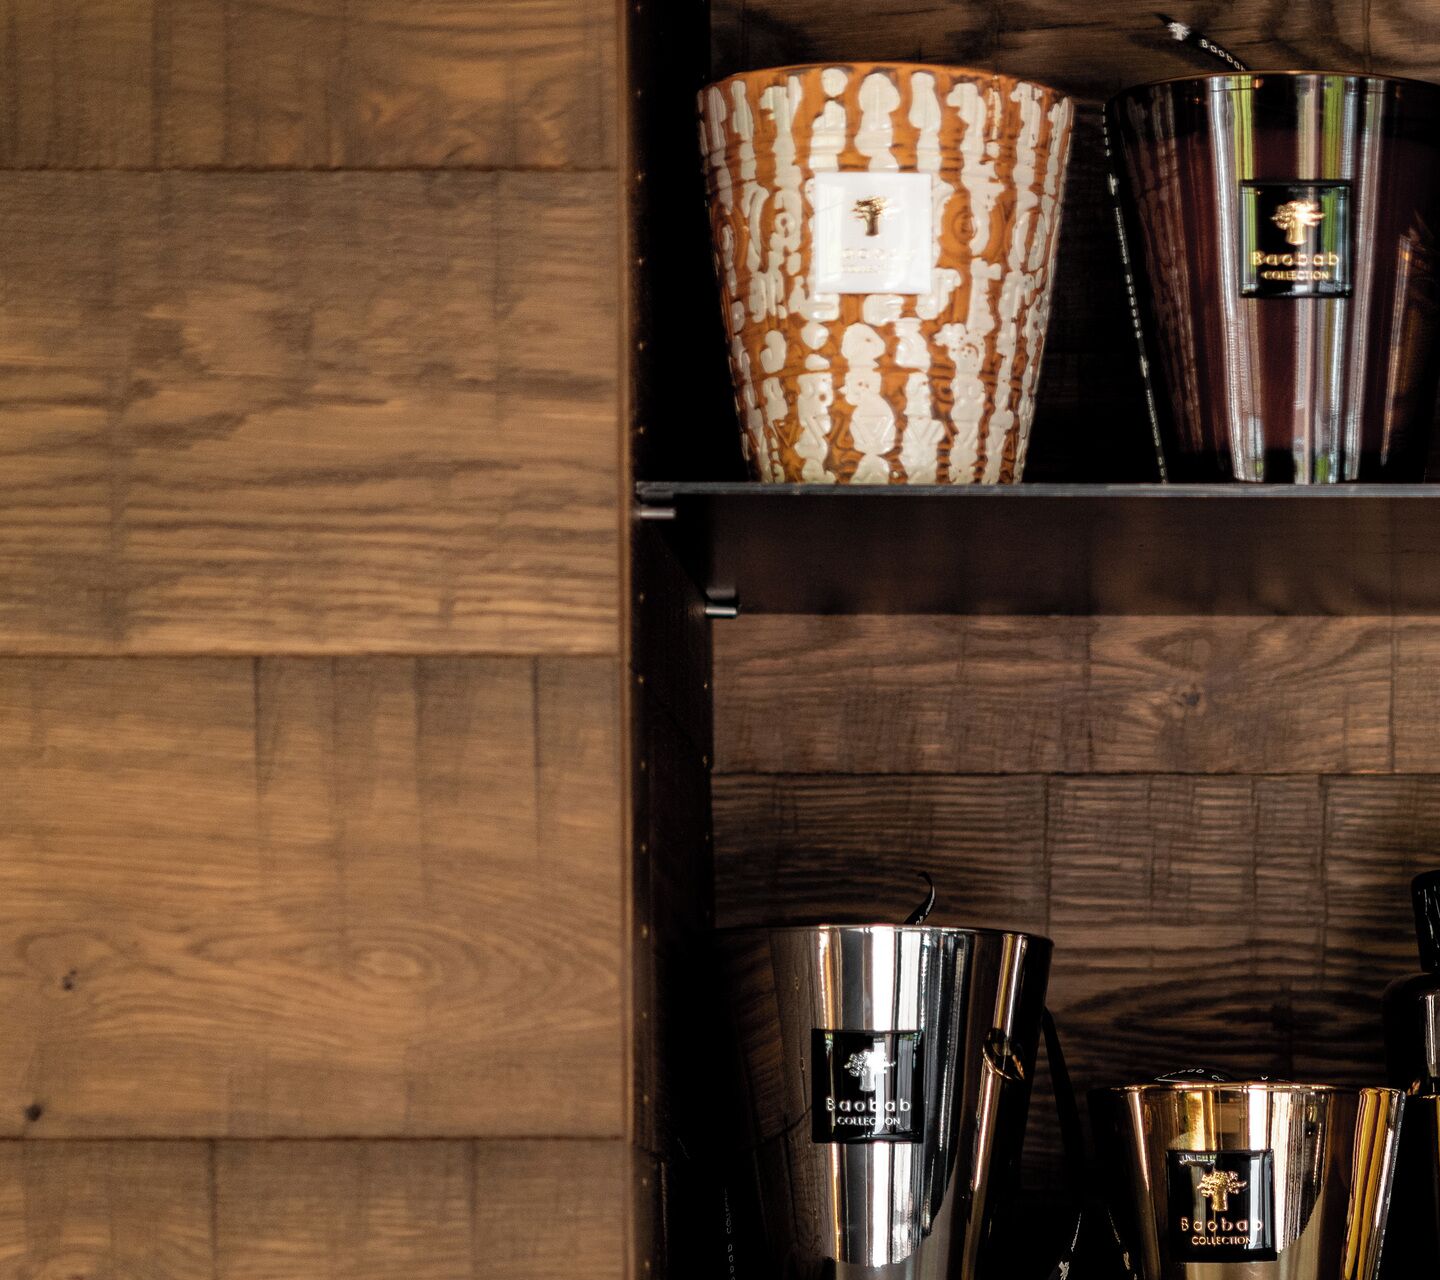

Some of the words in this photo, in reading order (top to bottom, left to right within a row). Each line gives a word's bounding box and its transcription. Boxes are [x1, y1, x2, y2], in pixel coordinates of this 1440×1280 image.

[1251, 251, 1340, 266] Baobab
[1263, 272, 1329, 280] COLLECTION
[1191, 1236, 1251, 1246] COLLECTION
